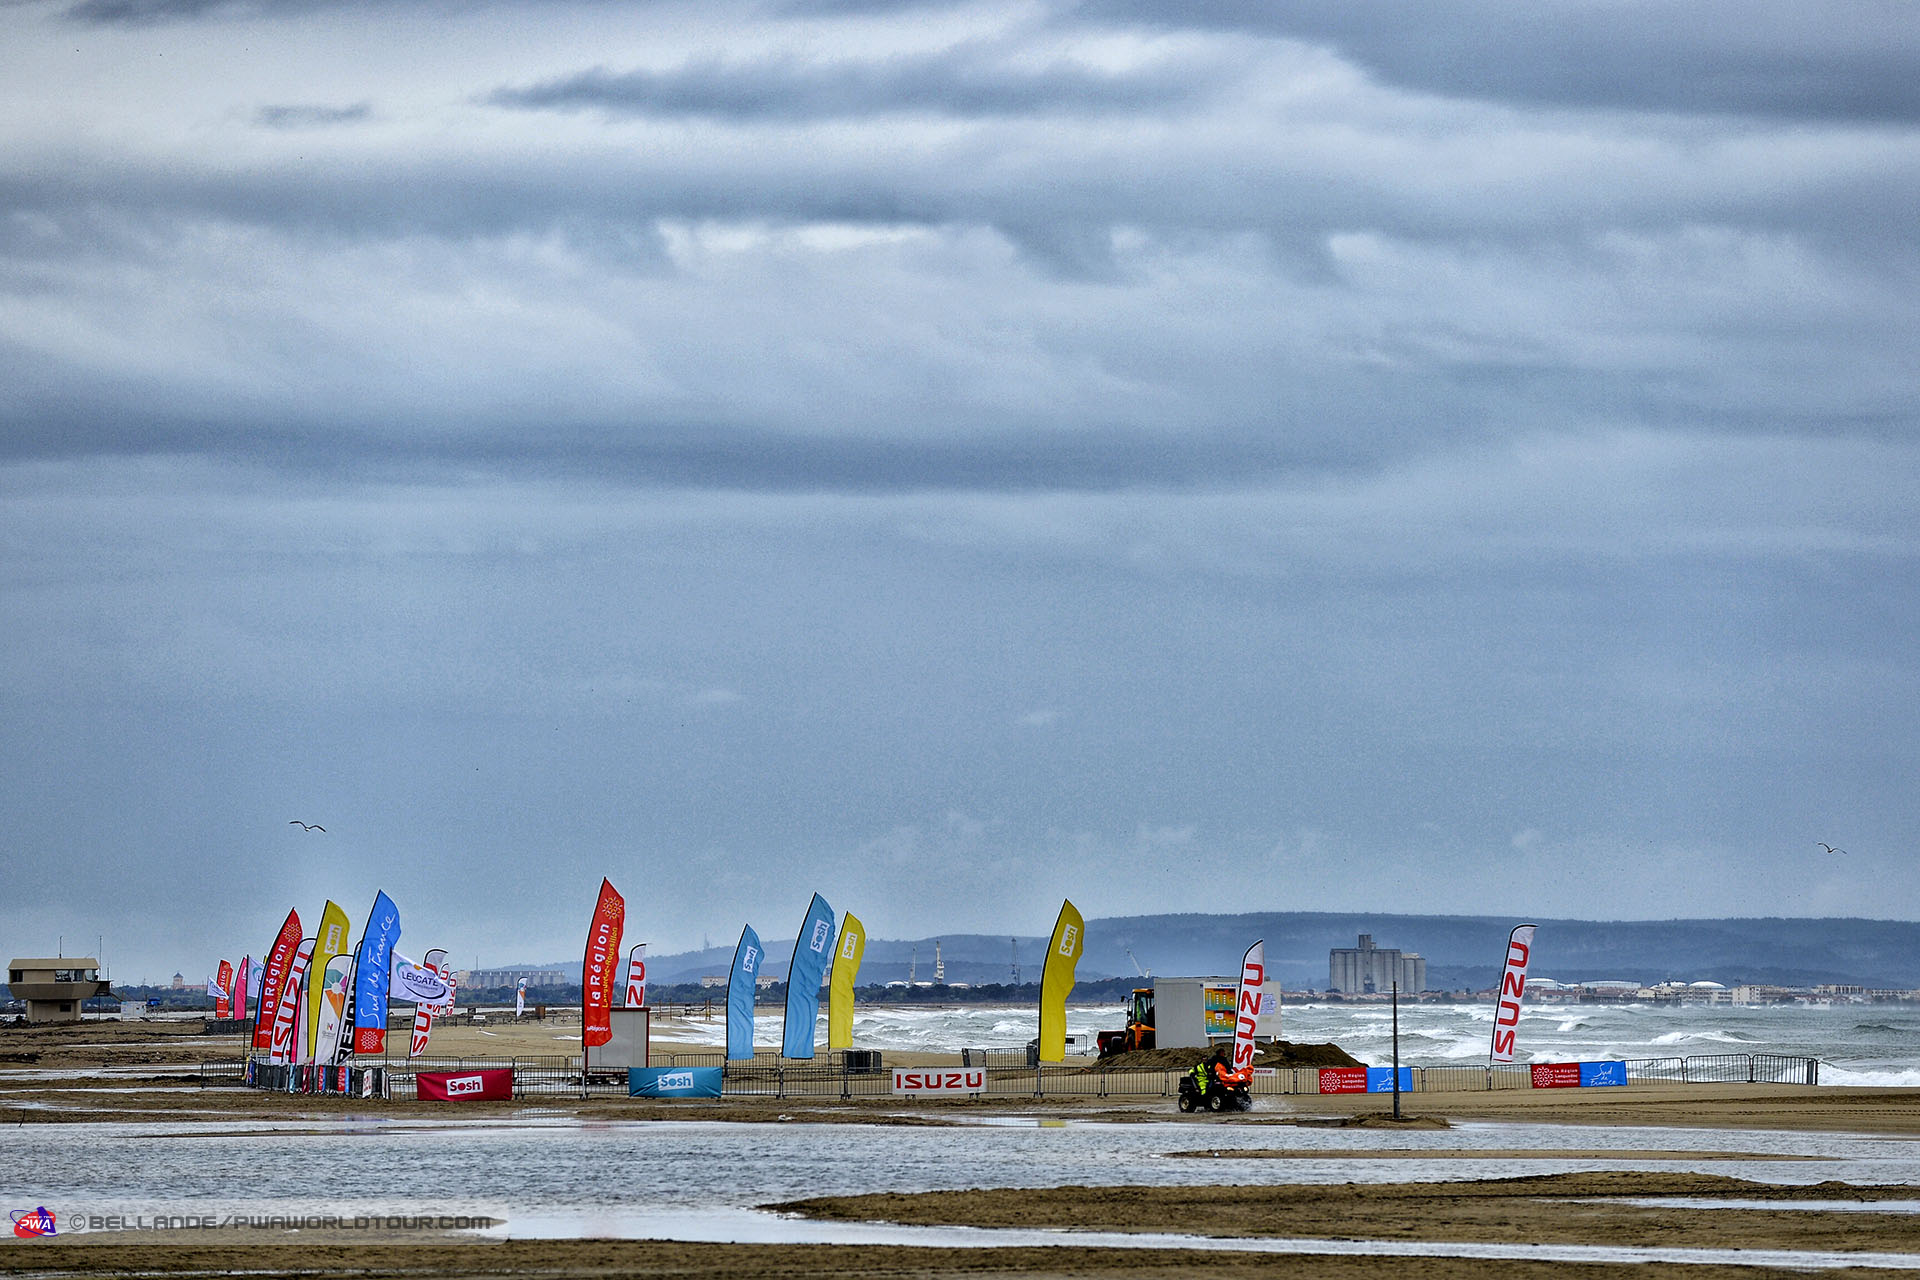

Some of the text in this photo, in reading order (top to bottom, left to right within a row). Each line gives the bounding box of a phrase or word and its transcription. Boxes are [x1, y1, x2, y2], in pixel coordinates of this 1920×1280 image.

[327, 926, 341, 952] Sosh
[812, 923, 829, 950] Sosh
[1062, 927, 1076, 954] Sosh
[843, 935, 856, 957] Sosh
[264, 944, 287, 996] Région
[360, 913, 396, 1030] Sud de France
[588, 923, 610, 1007] la Région
[402, 971, 439, 986] LEUCATE
[263, 1001, 274, 1014] la
[1593, 1063, 1612, 1077] Sud
[450, 1079, 481, 1091] Sosh
[661, 1076, 691, 1087] Sosh
[896, 1072, 983, 1089] ISUZU
[1377, 1083, 1404, 1092] Frane
[1590, 1078, 1617, 1086] France
